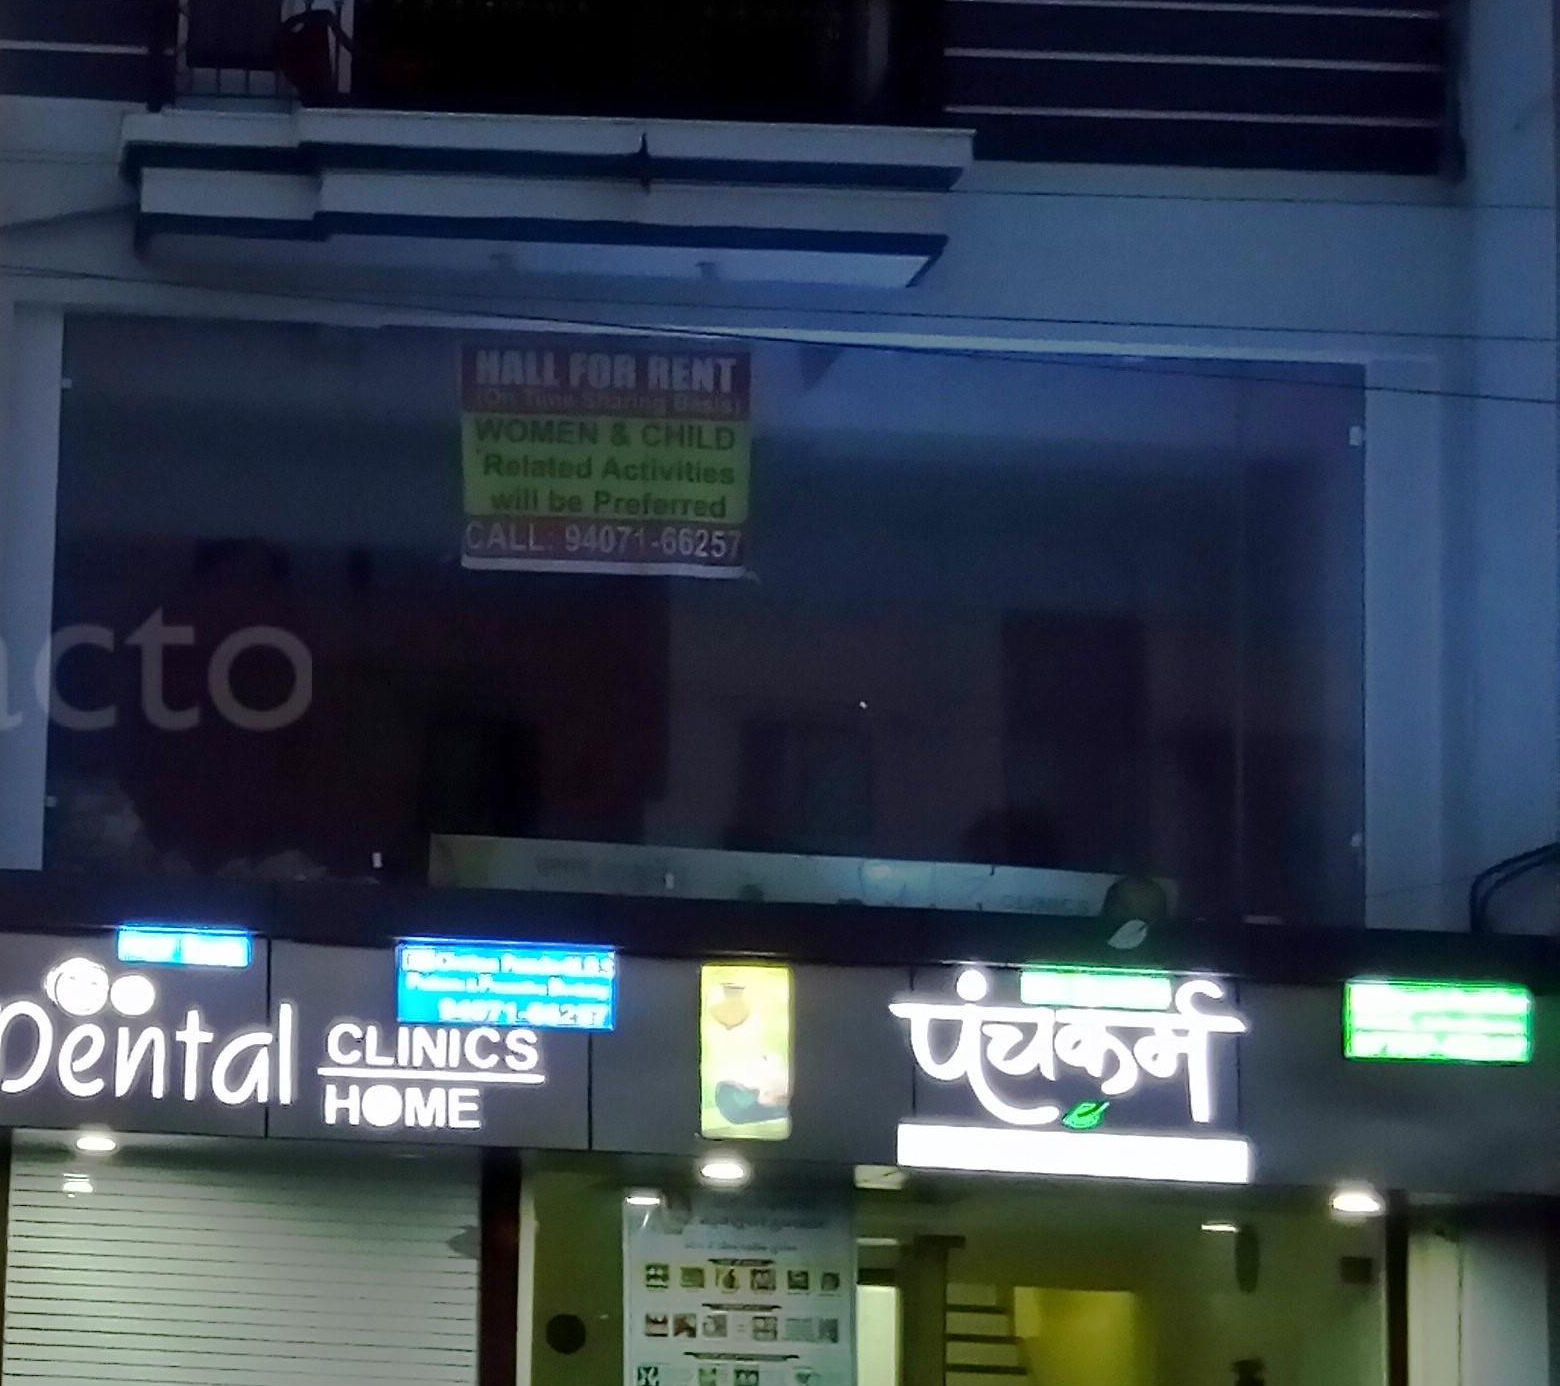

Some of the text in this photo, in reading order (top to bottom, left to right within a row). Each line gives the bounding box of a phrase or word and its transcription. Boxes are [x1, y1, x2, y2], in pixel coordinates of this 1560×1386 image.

[474, 349, 737, 394] HALL FOR RENT
[475, 418, 736, 451] WOMEN & CHILD
[483, 453, 736, 485] Related Activities
[489, 488, 727, 519] will be Preferred
[325, 1023, 541, 1072] CLINICS
[888, 968, 1248, 1126] पंचकर्म
[323, 1084, 483, 1130] HOME
